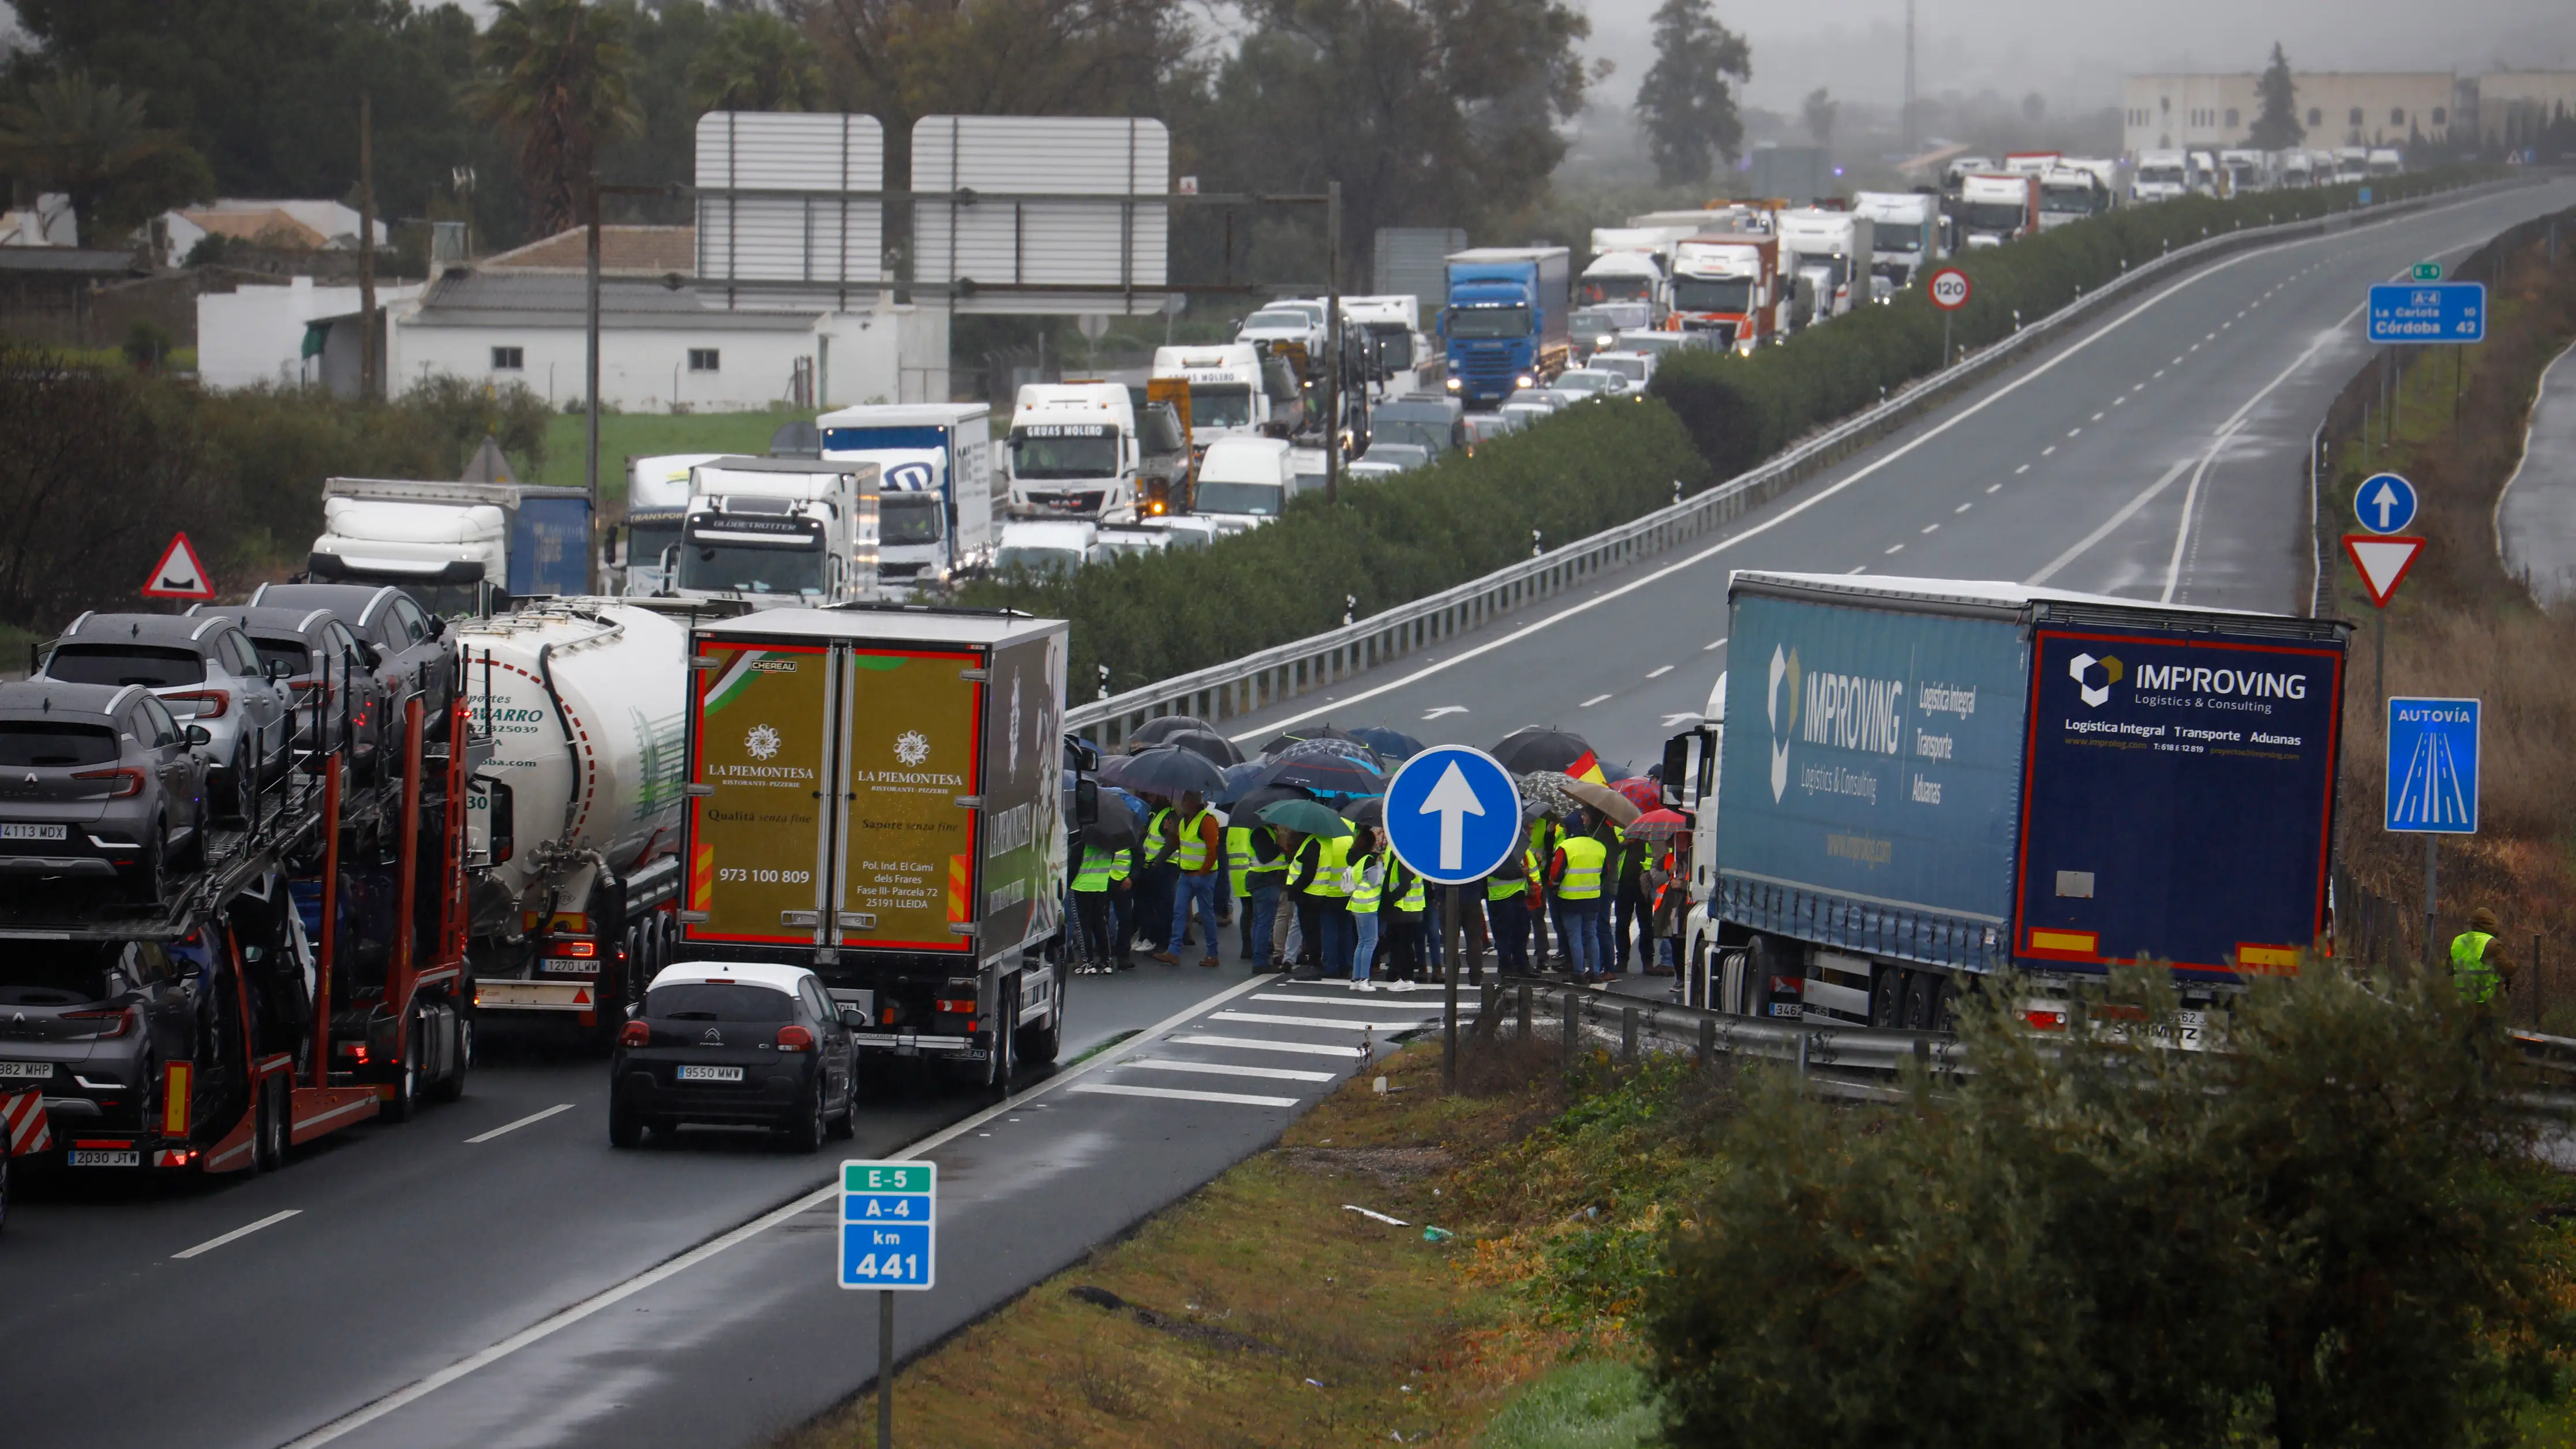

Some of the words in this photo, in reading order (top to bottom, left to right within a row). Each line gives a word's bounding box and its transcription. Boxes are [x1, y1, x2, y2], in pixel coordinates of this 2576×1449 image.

[1936, 282, 1964, 296] 120
[2414, 293, 2436, 303] A-4
[2375, 308, 2389, 317] La
[2396, 307, 2439, 317] Carlota
[2463, 307, 2476, 317] 10
[2375, 319, 2440, 334] Córdoba
[1201, 373, 1234, 381] MOLERO
[1027, 426, 1061, 437] GRUAS
[1064, 425, 1103, 436] MOLERO
[713, 520, 797, 530] GLOBETROTTER
[752, 661, 795, 671] CHEREAU
[2136, 664, 2307, 699] IMPROVING
[467, 693, 512, 704] potes
[1919, 681, 1949, 717] Logística
[1950, 684, 1976, 720] Integral
[2135, 694, 2191, 707] Logistics
[2195, 698, 2204, 707] &
[2207, 699, 2272, 715] Consulting
[1804, 671, 1903, 755] IMPROVING
[2398, 707, 2470, 723] AUTOVÍA
[2065, 719, 2118, 733] Logística
[2120, 722, 2165, 737] Integral
[2174, 726, 2241, 742] Transporte
[2250, 731, 2301, 746] Aduanas
[1916, 728, 1952, 765] Transporte
[2064, 737, 2147, 750] www.improlog.com
[2161, 743, 2174, 751] 618
[2190, 744, 2204, 753] 819
[709, 765, 726, 776] LA
[729, 765, 814, 779] PIEMONTESA
[858, 771, 875, 782] LA
[878, 772, 963, 785] PIEMONTESA
[871, 785, 915, 793] RISTORANTI
[1800, 761, 1833, 796] Logistics
[1834, 766, 1840, 793] &
[1840, 767, 1877, 806] Consulting
[1912, 773, 1941, 804] Aduanas
[708, 809, 755, 822] Qualità
[758, 814, 788, 823] senza
[789, 813, 812, 826] fine
[3, 825, 36, 837] 4113
[39, 826, 63, 838] MDX
[862, 819, 903, 832] Sapore
[905, 822, 934, 832] senza
[937, 821, 959, 834] fine
[863, 861, 879, 870] Pol.
[881, 861, 898, 871] Ind.
[900, 862, 908, 871] El
[910, 863, 934, 872] Camí
[720, 868, 747, 882] 973
[752, 869, 778, 882] 100
[781, 870, 810, 883] 809
[874, 874, 893, 883] dels
[895, 875, 922, 884] Frares
[857, 885, 877, 895] Fase
[892, 887, 924, 897] Parcela
[927, 889, 938, 897] 72
[866, 898, 893, 908] 25191
[896, 900, 928, 909] LLEIDA
[549, 960, 574, 971] 1270
[578, 960, 598, 972] LWW
[25, 1065, 50, 1076] MHP
[686, 1068, 715, 1078] 9550
[717, 1068, 740, 1079] MMW
[77, 1152, 109, 1164] 2030
[113, 1153, 137, 1165] JTW
[868, 1170, 907, 1188] E-5
[866, 1199, 910, 1218] A-4
[873, 1230, 900, 1245] km
[856, 1253, 917, 1280] 441
